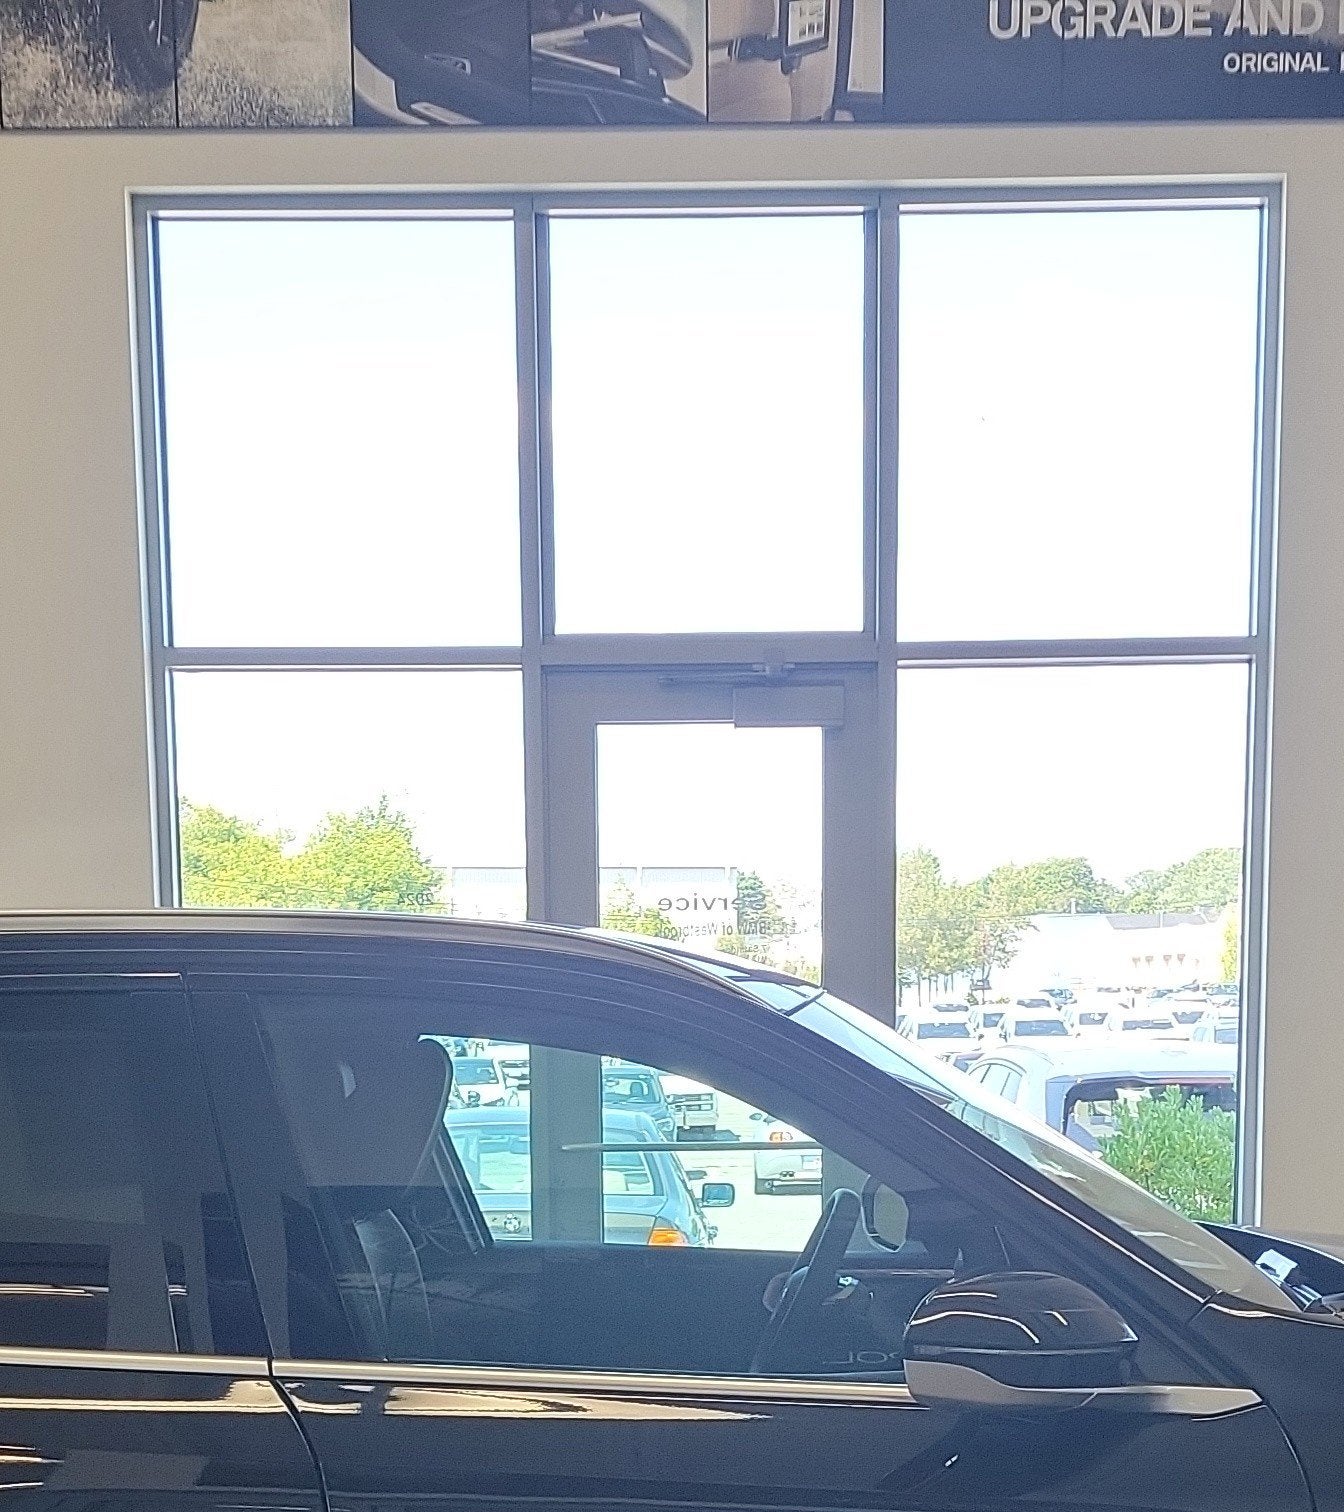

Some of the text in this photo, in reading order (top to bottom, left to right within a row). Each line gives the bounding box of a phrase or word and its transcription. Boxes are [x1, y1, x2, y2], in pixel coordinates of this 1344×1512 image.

[989, 0, 1213, 40] UPGRADE
[1223, 0, 1324, 37] AND
[1223, 51, 1330, 74] ORIGINAL
